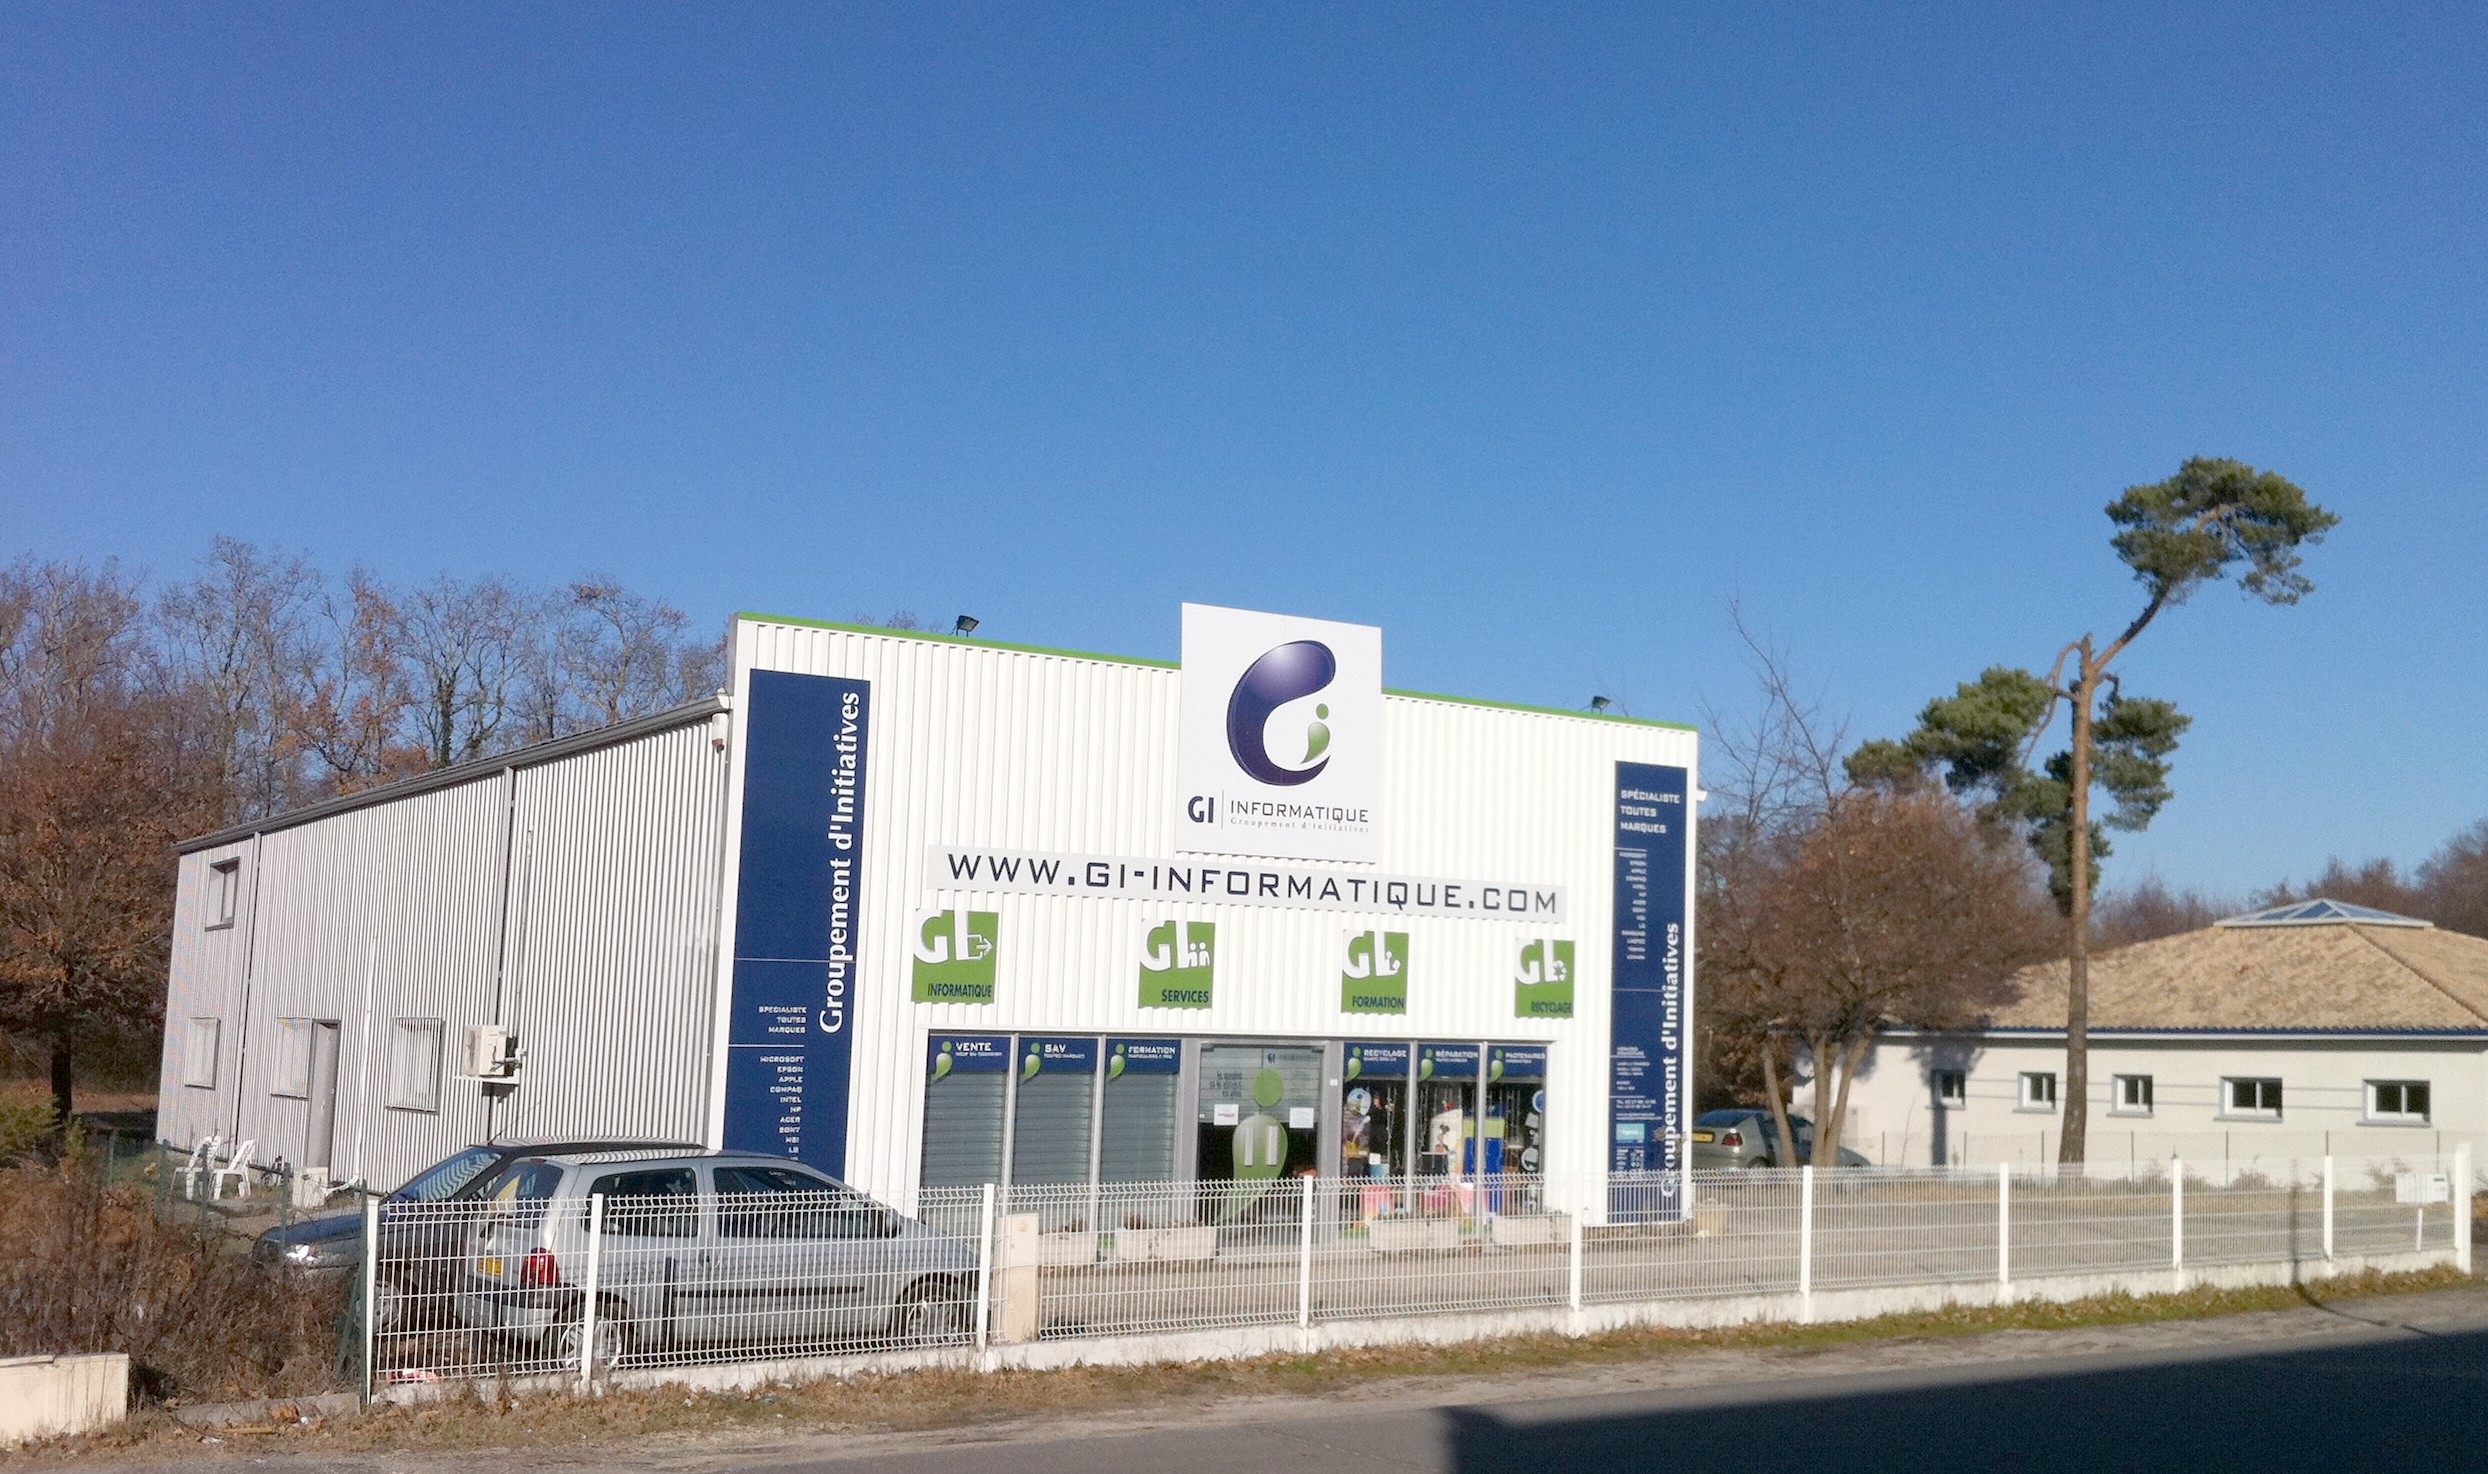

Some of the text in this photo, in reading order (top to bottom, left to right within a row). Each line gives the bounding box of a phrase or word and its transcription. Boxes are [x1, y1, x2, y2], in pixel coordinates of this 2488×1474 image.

[1620, 788, 1680, 804] SPÉCIALISTE
[1187, 795, 1369, 823] GI INFORMATIQUE
[1620, 805, 1657, 817] TOUTES
[1230, 817, 1296, 829] Groupement
[1620, 822, 1666, 834] MARQUES
[818, 691, 860, 1034] Groupement d'Initiatives
[948, 853, 1556, 914] WWW.GI-INFORMATIQUE.COM
[927, 982, 992, 999] INFORMATIQUE
[1661, 922, 1679, 1051] d'Initiatives
[1161, 989, 1209, 1003] SERVICES
[1352, 995, 1405, 1010] FORMATION
[1531, 1000, 1574, 1014] RECYCLAGE
[768, 1026, 806, 1034] MARQUES
[955, 1042, 992, 1052] VENTE
[1044, 1043, 1067, 1053] SAV
[1363, 1048, 1407, 1057] RECYCLAGE
